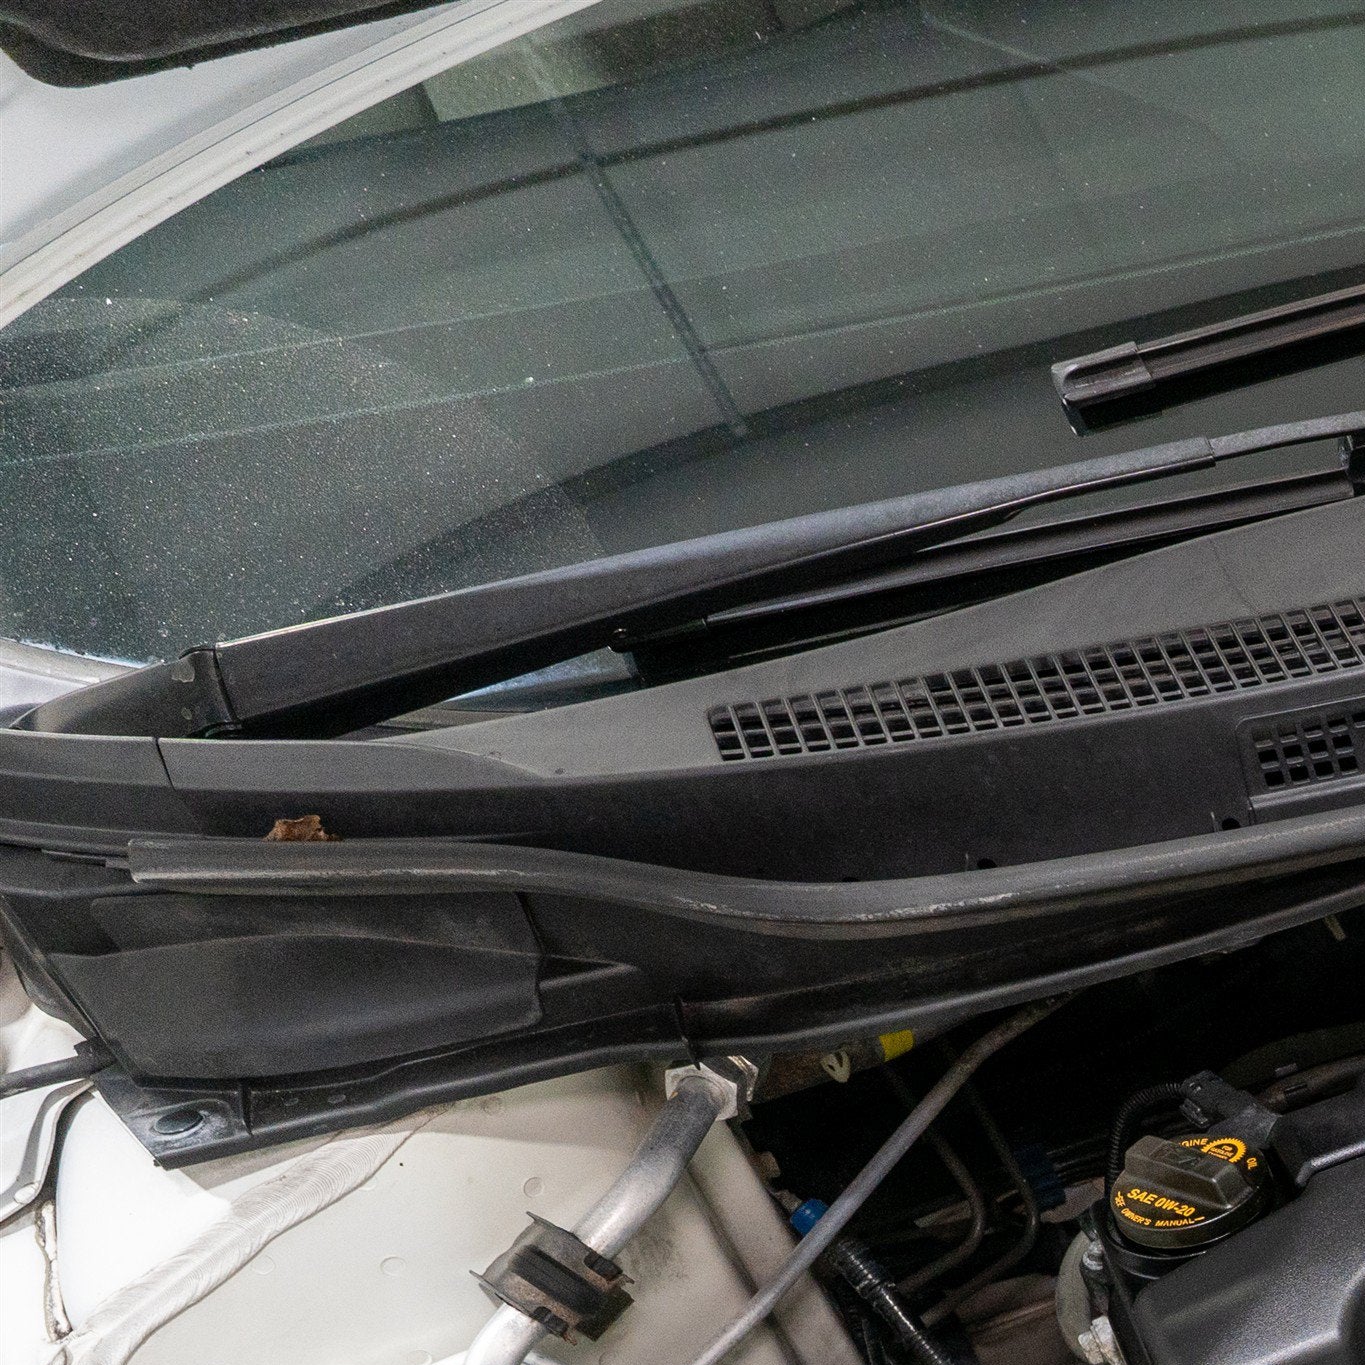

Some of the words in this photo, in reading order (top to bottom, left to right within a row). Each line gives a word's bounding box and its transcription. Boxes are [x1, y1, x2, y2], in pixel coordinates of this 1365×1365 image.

[1180, 1138, 1209, 1147] GINE
[1246, 1156, 1258, 1170] OIL
[1120, 1207, 1152, 1227] OWNER'S
[1154, 1217, 1195, 1227] MANUAL
[1127, 1188, 1156, 1204] SAE
[1154, 1197, 1196, 1217] 0W-20
